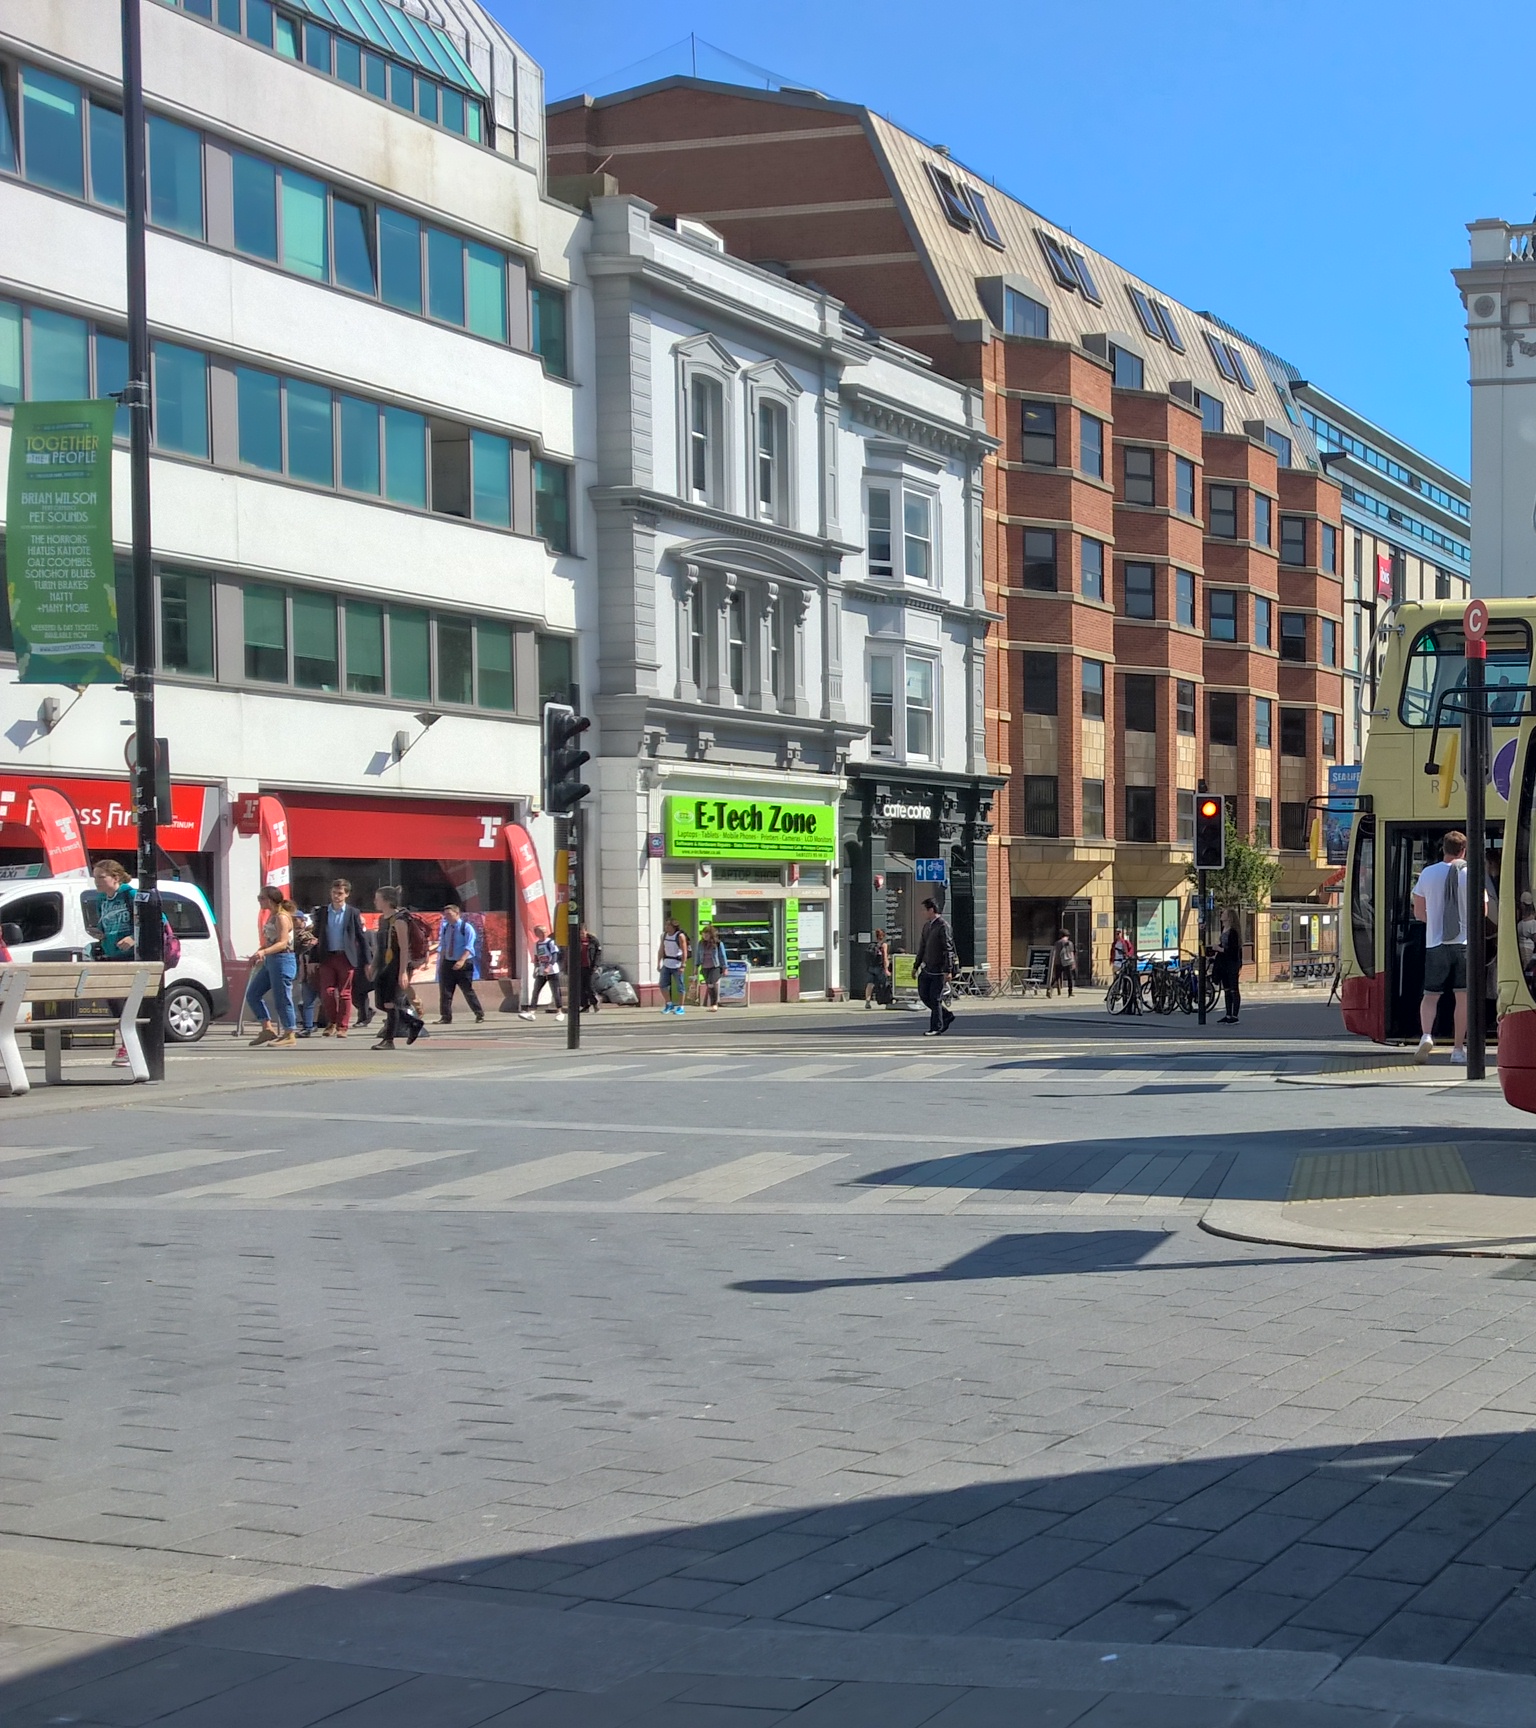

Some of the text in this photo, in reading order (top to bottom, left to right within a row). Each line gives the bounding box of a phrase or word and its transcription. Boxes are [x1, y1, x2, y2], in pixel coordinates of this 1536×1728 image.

[26, 435, 98, 451] TOGETHER
[52, 451, 96, 464] PEOPLE
[21, 492, 97, 505] BRIAN WILSON
[29, 511, 88, 522] PET SOUNDS
[31, 535, 87, 544] THE HORRORS
[28, 546, 55, 555] HIATUS
[27, 558, 92, 567] GAZ COOMBES
[25, 569, 96, 578] SONGHOY BLUES
[1380, 567, 1389, 584] ibis
[58, 581, 88, 589] BRAKES
[50, 592, 73, 601] NATTY
[65, 604, 89, 612] MORE
[1469, 609, 1481, 632] C
[1332, 772, 1360, 782] SEA LIFE
[907, 803, 931, 819] coho
[694, 801, 817, 834] E-Tech Zone
[678, 830, 698, 839] Laptops
[739, 832, 756, 840] Phones
[781, 834, 800, 842] Cameras
[713, 870, 782, 881] LAPTOP SHOP
